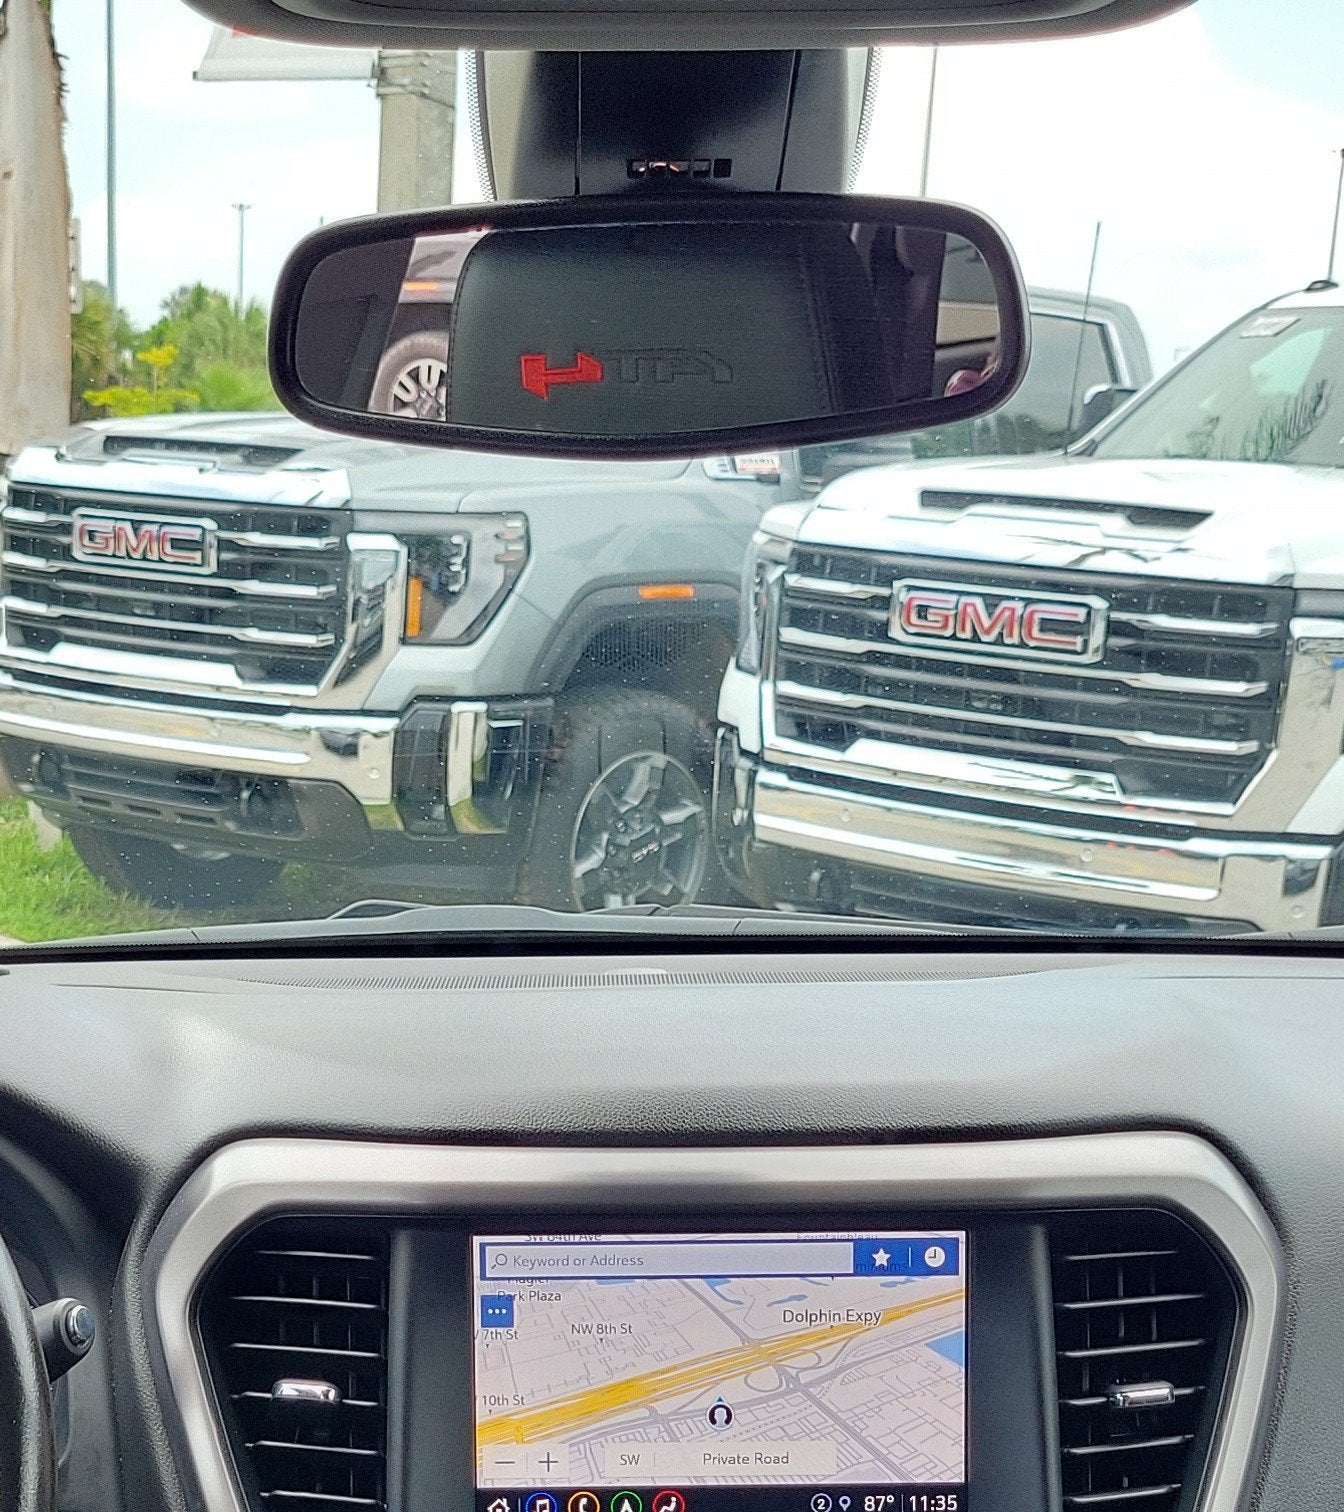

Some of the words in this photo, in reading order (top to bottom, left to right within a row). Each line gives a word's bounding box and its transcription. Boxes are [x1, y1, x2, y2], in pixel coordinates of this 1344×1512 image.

[78, 518, 204, 567] GMC
[900, 590, 1090, 652] GMC
[513, 1255, 569, 1270] Keyword
[573, 1257, 587, 1266] or
[590, 1255, 644, 1266] Address
[529, 1290, 562, 1302] Plaza
[783, 1309, 842, 1325] Dolphin
[846, 1309, 882, 1325] Expy
[506, 1329, 519, 1340] St
[571, 1323, 593, 1335] NW
[596, 1323, 617, 1335] 8th
[620, 1323, 633, 1335] St
[482, 1395, 509, 1406] 10th
[512, 1395, 525, 1406] St
[620, 1454, 640, 1466] SW
[703, 1453, 750, 1465] Private
[754, 1452, 790, 1465] Road
[910, 1495, 958, 1511] 11:35
